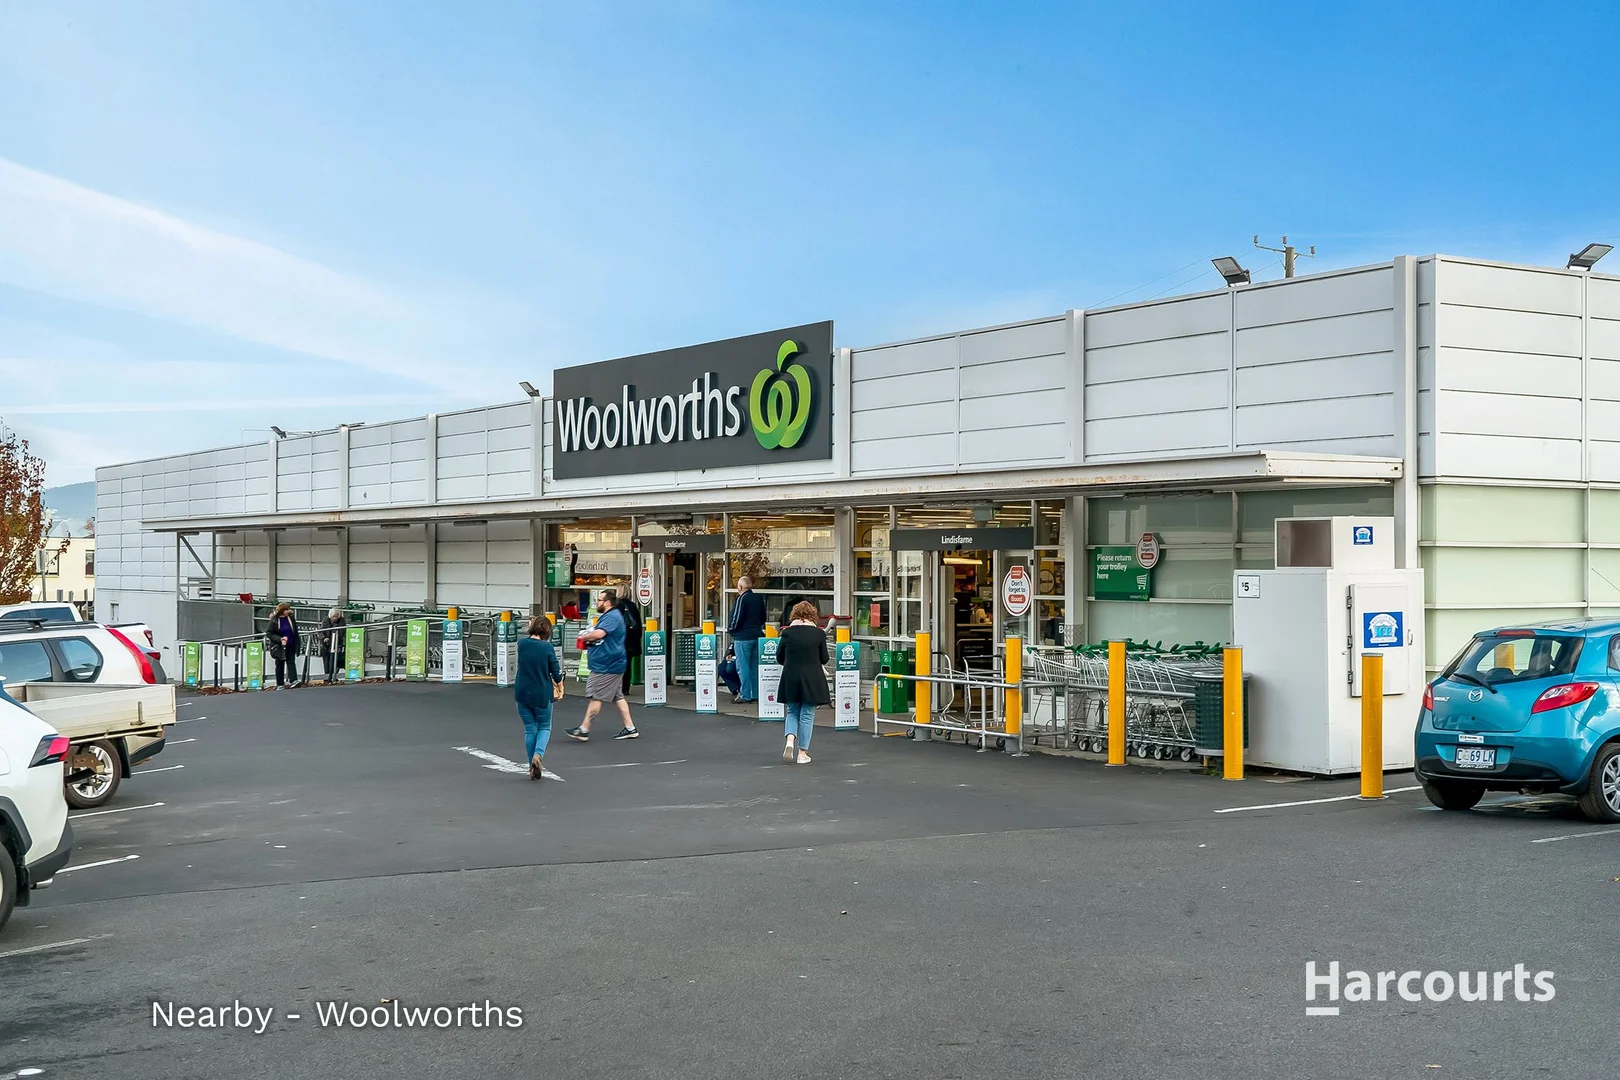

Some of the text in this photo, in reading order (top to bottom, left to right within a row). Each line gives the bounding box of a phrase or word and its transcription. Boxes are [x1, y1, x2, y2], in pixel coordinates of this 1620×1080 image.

[557, 372, 741, 452] Woolworths
[941, 535, 973, 544] Lindisfarne
[1096, 554, 1114, 562] Please
[1110, 562, 1128, 572] trolley
[1242, 582, 1250, 592] $5
[1470, 750, 1480, 762] 69
[1482, 751, 1494, 762] LK
